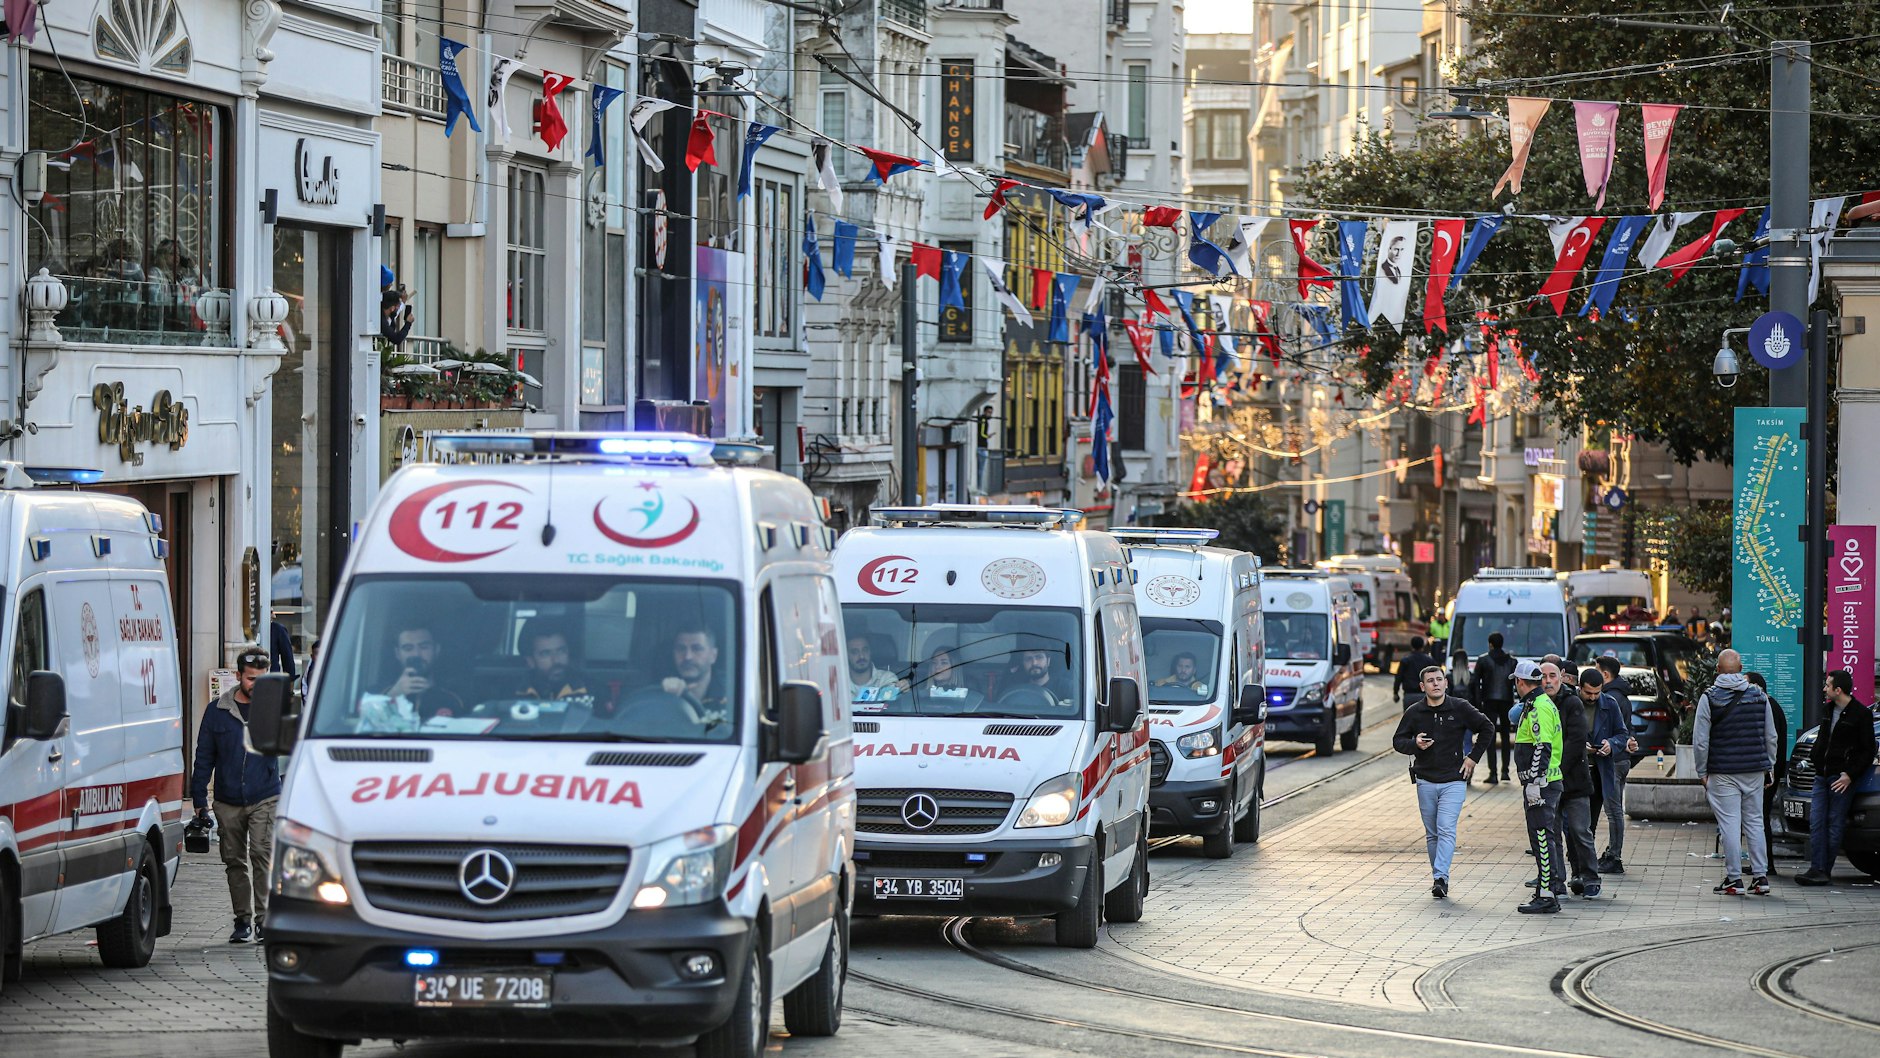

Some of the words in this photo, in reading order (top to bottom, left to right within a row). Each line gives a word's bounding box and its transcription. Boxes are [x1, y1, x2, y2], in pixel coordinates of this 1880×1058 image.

[948, 65, 960, 153] CHANGE
[1756, 417, 1784, 426] TAKSİM
[436, 501, 524, 530] 112
[567, 553, 590, 565] T.C.
[595, 553, 644, 568] Sağlık
[650, 555, 724, 572] Bakanlığı
[874, 567, 919, 584] 112
[1755, 634, 1780, 643] TÜNEL
[141, 658, 157, 705] 112
[80, 785, 123, 815] AMBULANS
[882, 879, 899, 895] 34
[906, 879, 923, 895] YB
[929, 880, 962, 896] 3504
[425, 976, 449, 1000] 34
[460, 977, 485, 1000] UE
[495, 977, 544, 1001] 7208
